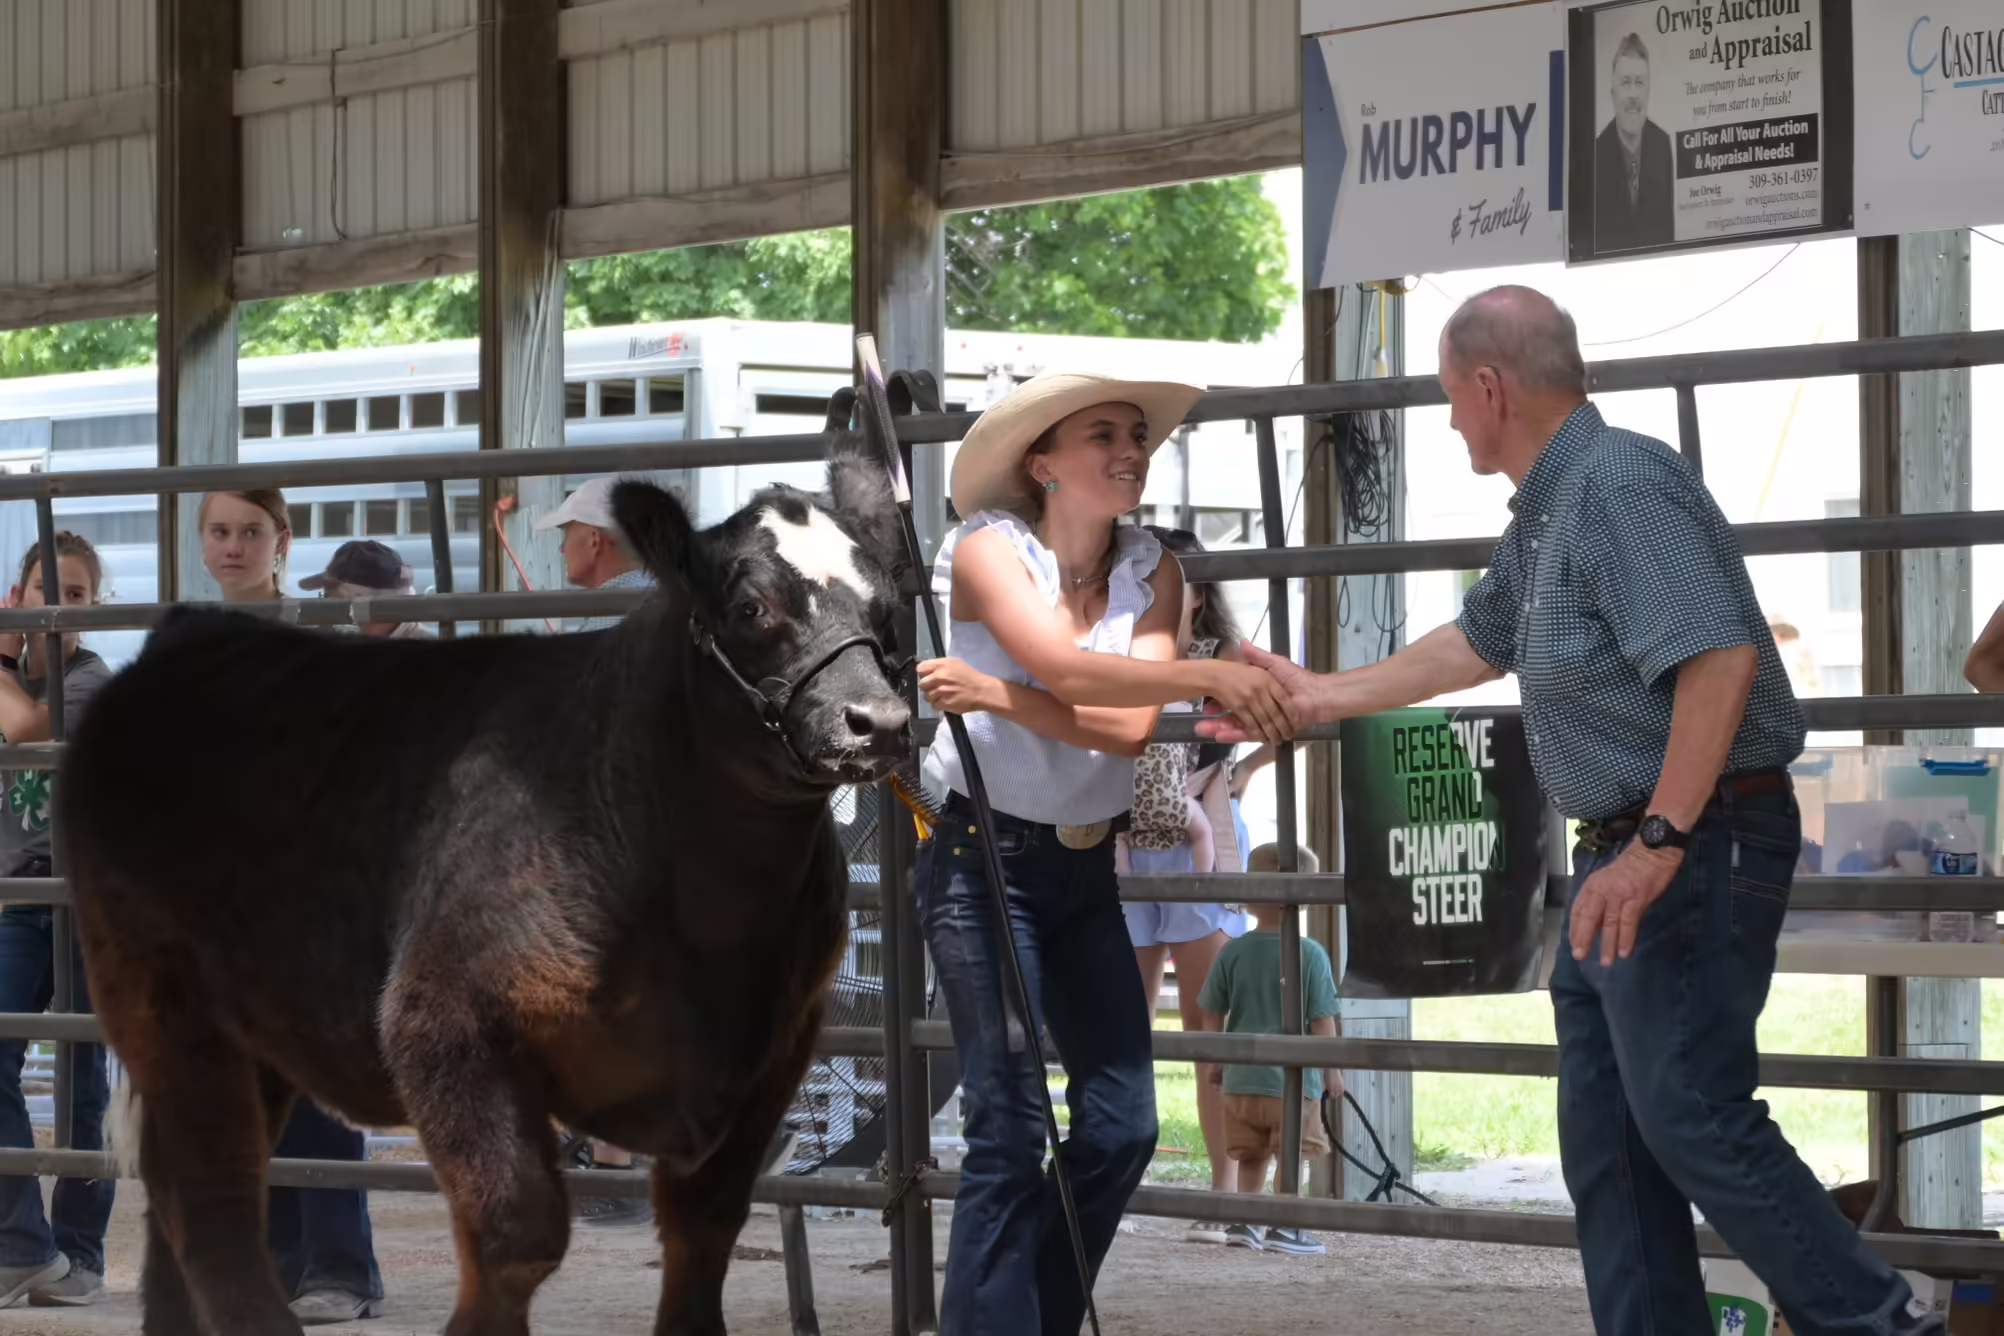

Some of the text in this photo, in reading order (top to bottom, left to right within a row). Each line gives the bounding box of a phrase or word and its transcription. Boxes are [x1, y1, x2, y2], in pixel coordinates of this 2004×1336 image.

[1656, 0, 1800, 35] Orwig Auction
[1689, 20, 1813, 70] and Appraisal
[1685, 67, 1802, 96] The company that works for
[1361, 102, 1376, 117] Rob
[1692, 90, 1792, 120] you from start to finish!
[1359, 102, 1536, 185] MURPHY
[1683, 119, 1809, 149] Call For All Your Auction
[1695, 142, 1795, 171] & Appraisal Needs!
[1748, 167, 1819, 189] 309-361-0397
[1450, 187, 1532, 245] & Family
[1392, 718, 1495, 774] RESERVE
[1407, 771, 1482, 823] GRAND
[1389, 821, 1505, 876] CHAMPION
[1412, 873, 1483, 925] STEER
